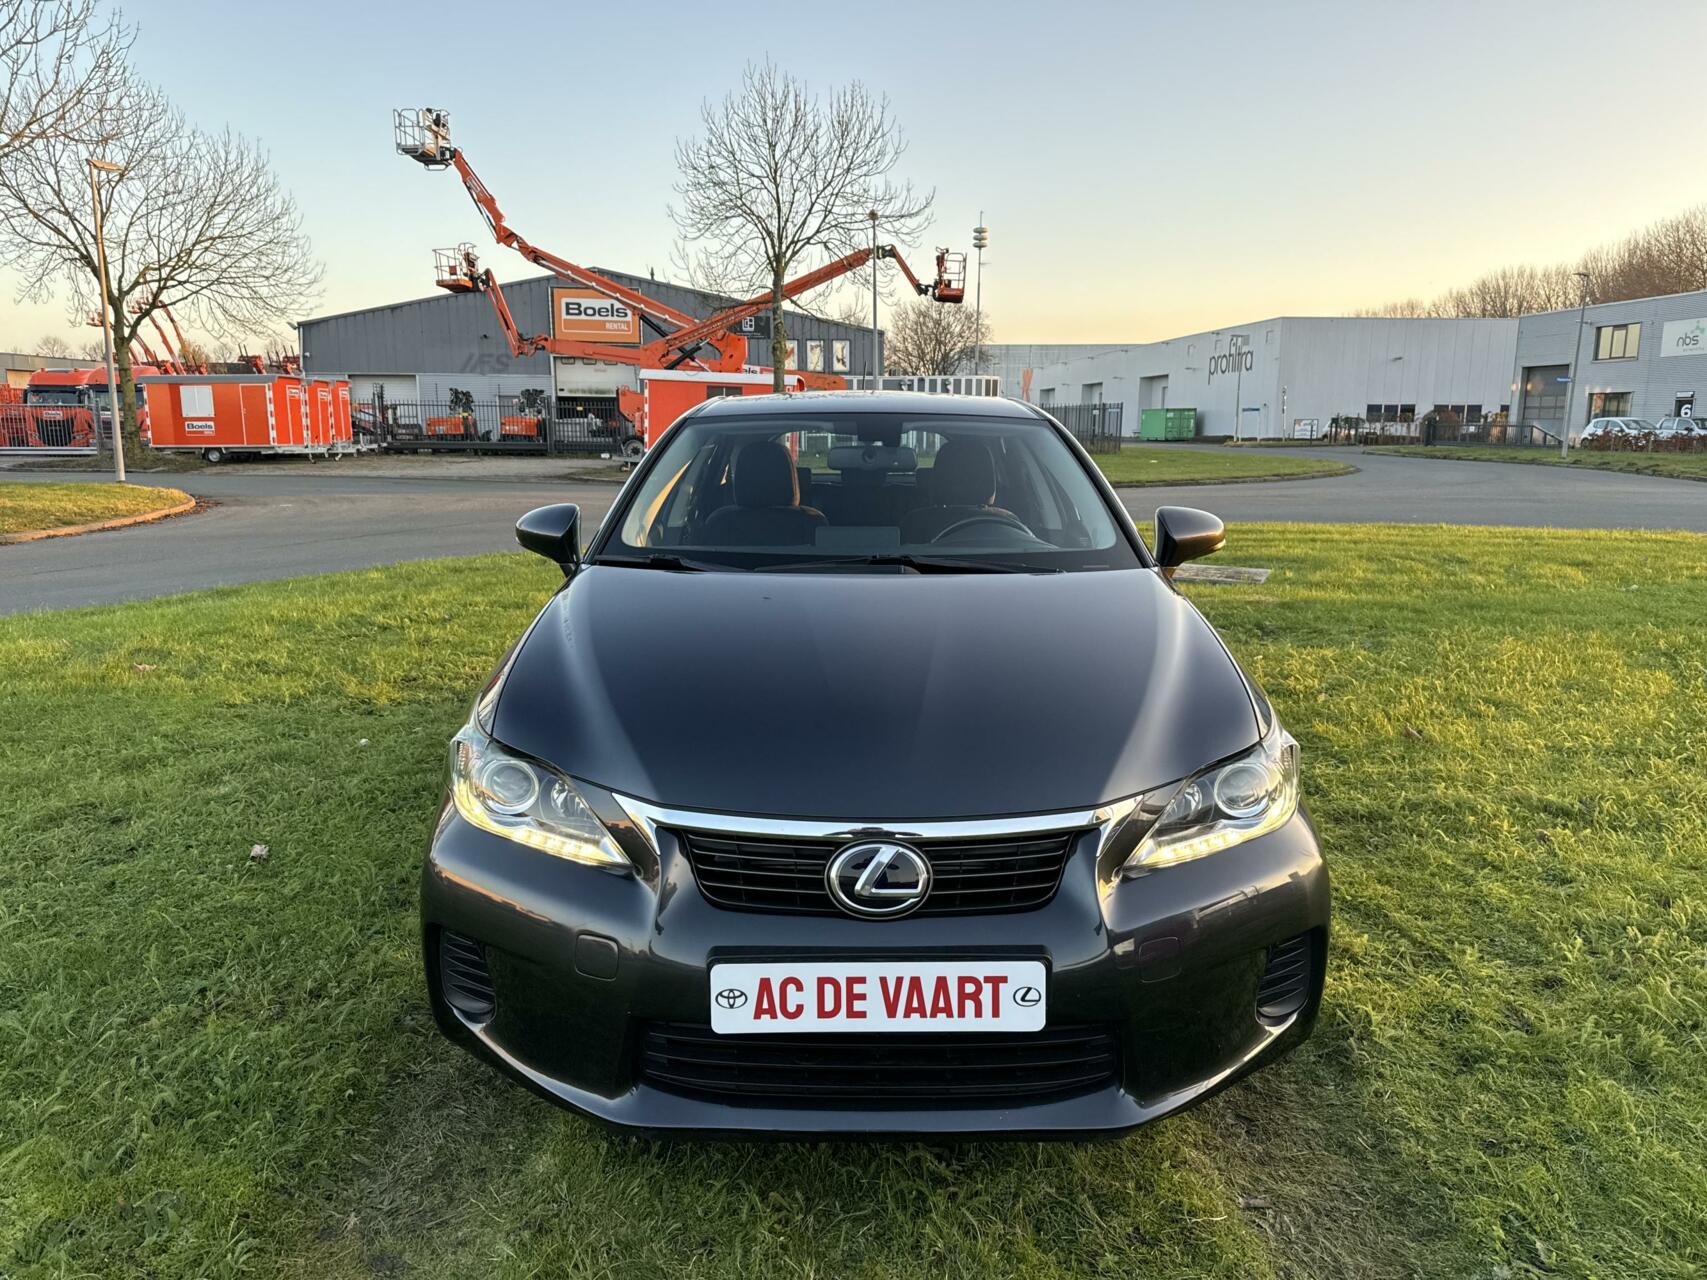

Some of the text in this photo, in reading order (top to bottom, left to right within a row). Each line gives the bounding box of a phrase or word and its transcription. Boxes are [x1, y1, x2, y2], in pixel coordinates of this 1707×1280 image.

[565, 302, 628, 318] Boels
[1676, 332, 1699, 347] nbs
[1208, 336, 1254, 386] profiltra
[1681, 404, 1691, 418] 6
[753, 975, 1008, 1020] AC DE VAART
